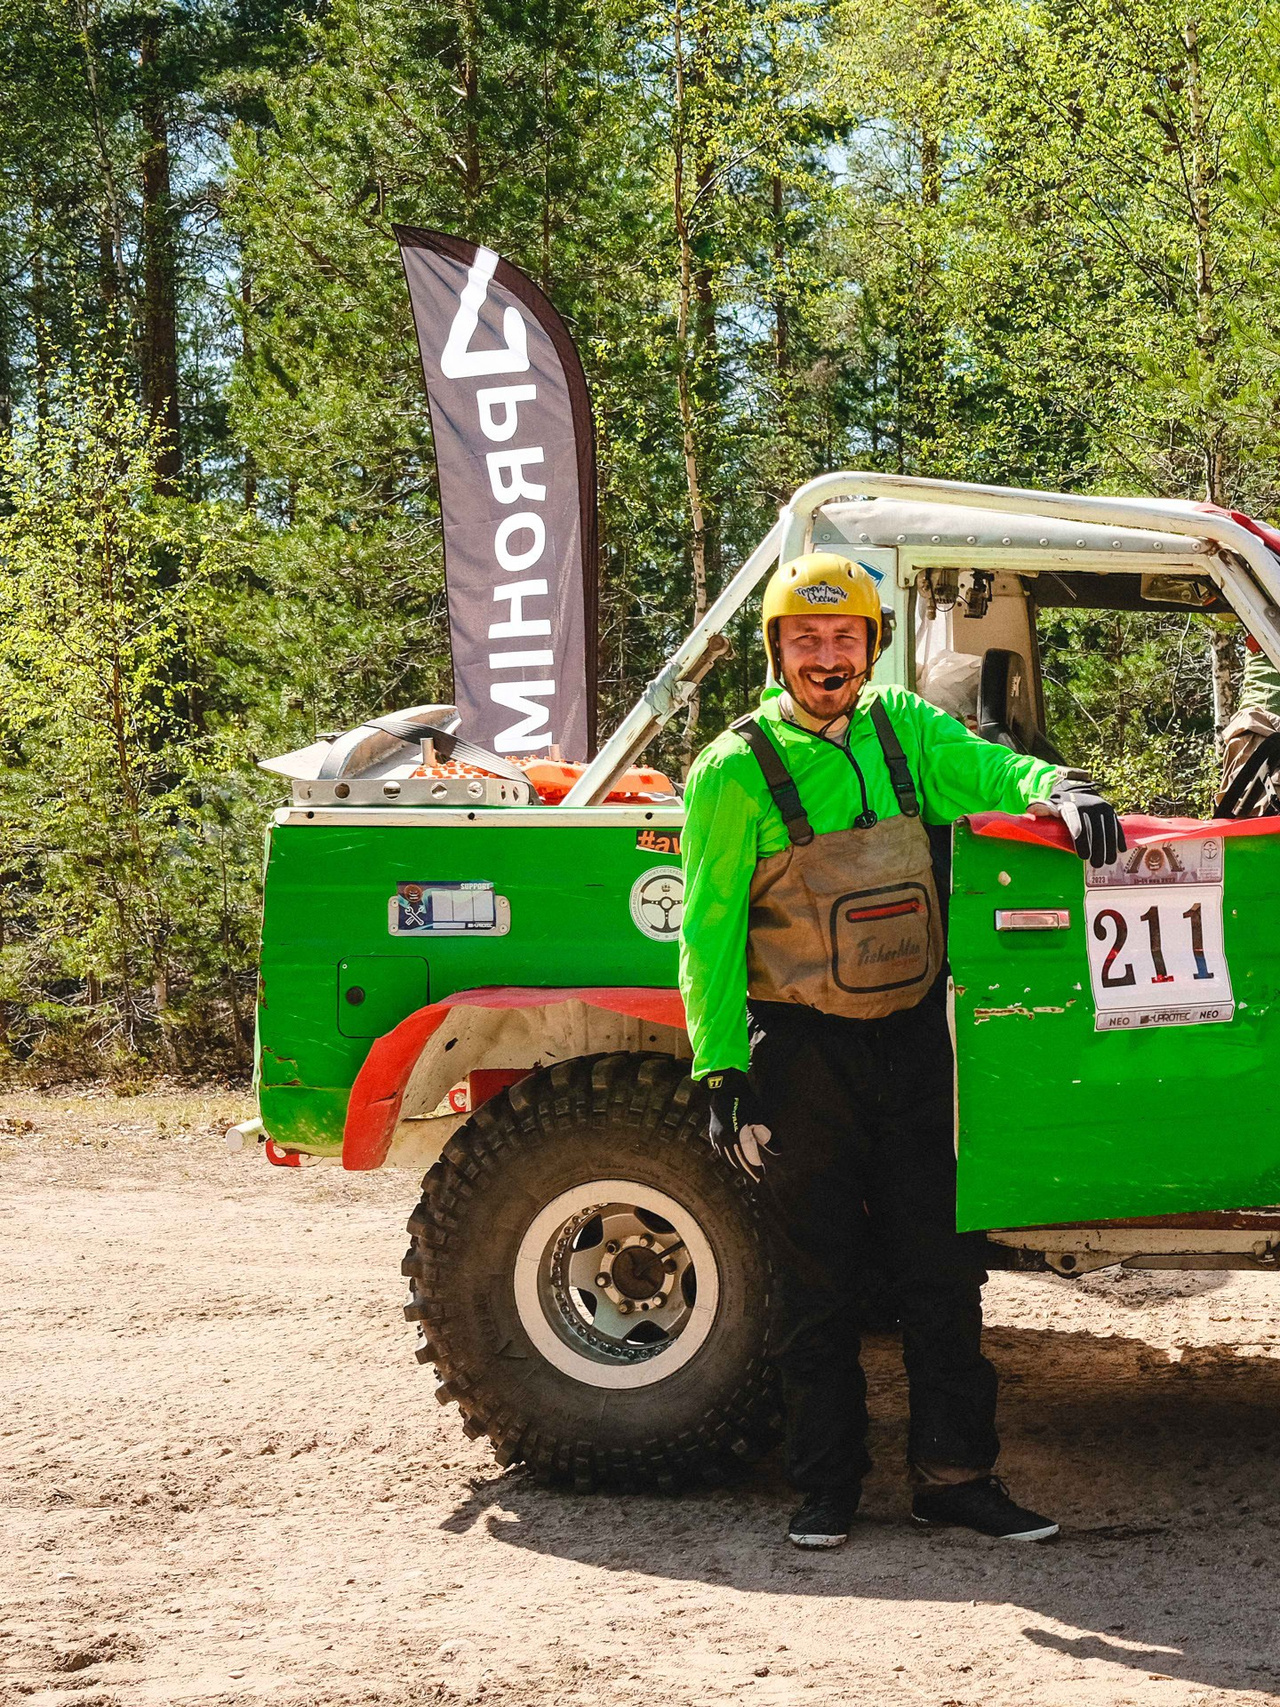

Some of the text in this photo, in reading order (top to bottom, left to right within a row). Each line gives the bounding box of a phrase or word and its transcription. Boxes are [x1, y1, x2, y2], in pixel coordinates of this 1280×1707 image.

[1093, 902, 1215, 988] 211
[1109, 1017, 1131, 1027] NEO
[1199, 1009, 1219, 1019] NEO
